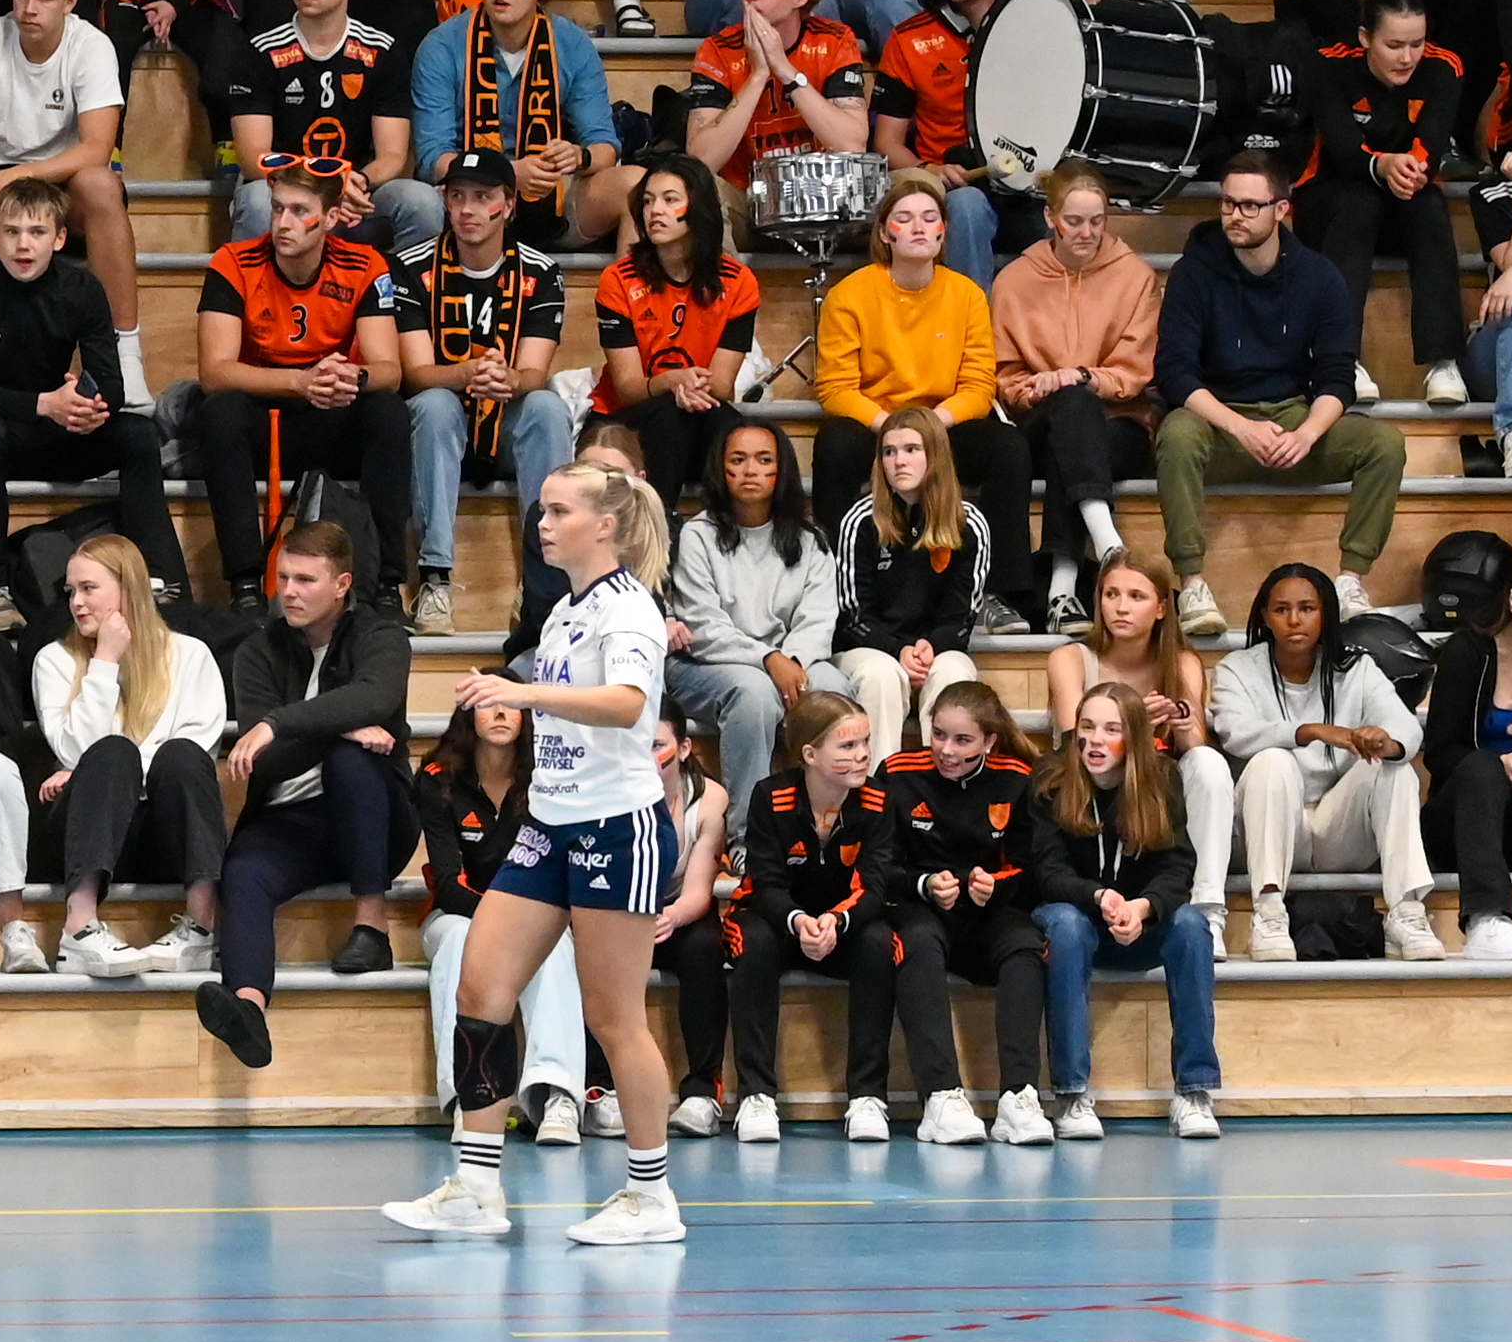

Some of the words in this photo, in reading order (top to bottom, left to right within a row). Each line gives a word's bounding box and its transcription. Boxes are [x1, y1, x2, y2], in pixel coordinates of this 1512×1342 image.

[272, 47, 304, 69] EXTRA
[344, 40, 378, 67] EXTRA
[319, 70, 334, 110] 8
[1243, 137, 1281, 150] adidas
[288, 305, 308, 343] 3
[669, 303, 687, 339] 9
[536, 758, 575, 770] TRIVSEL
[538, 745, 586, 759] TRENING
[516, 823, 553, 858] EMA
